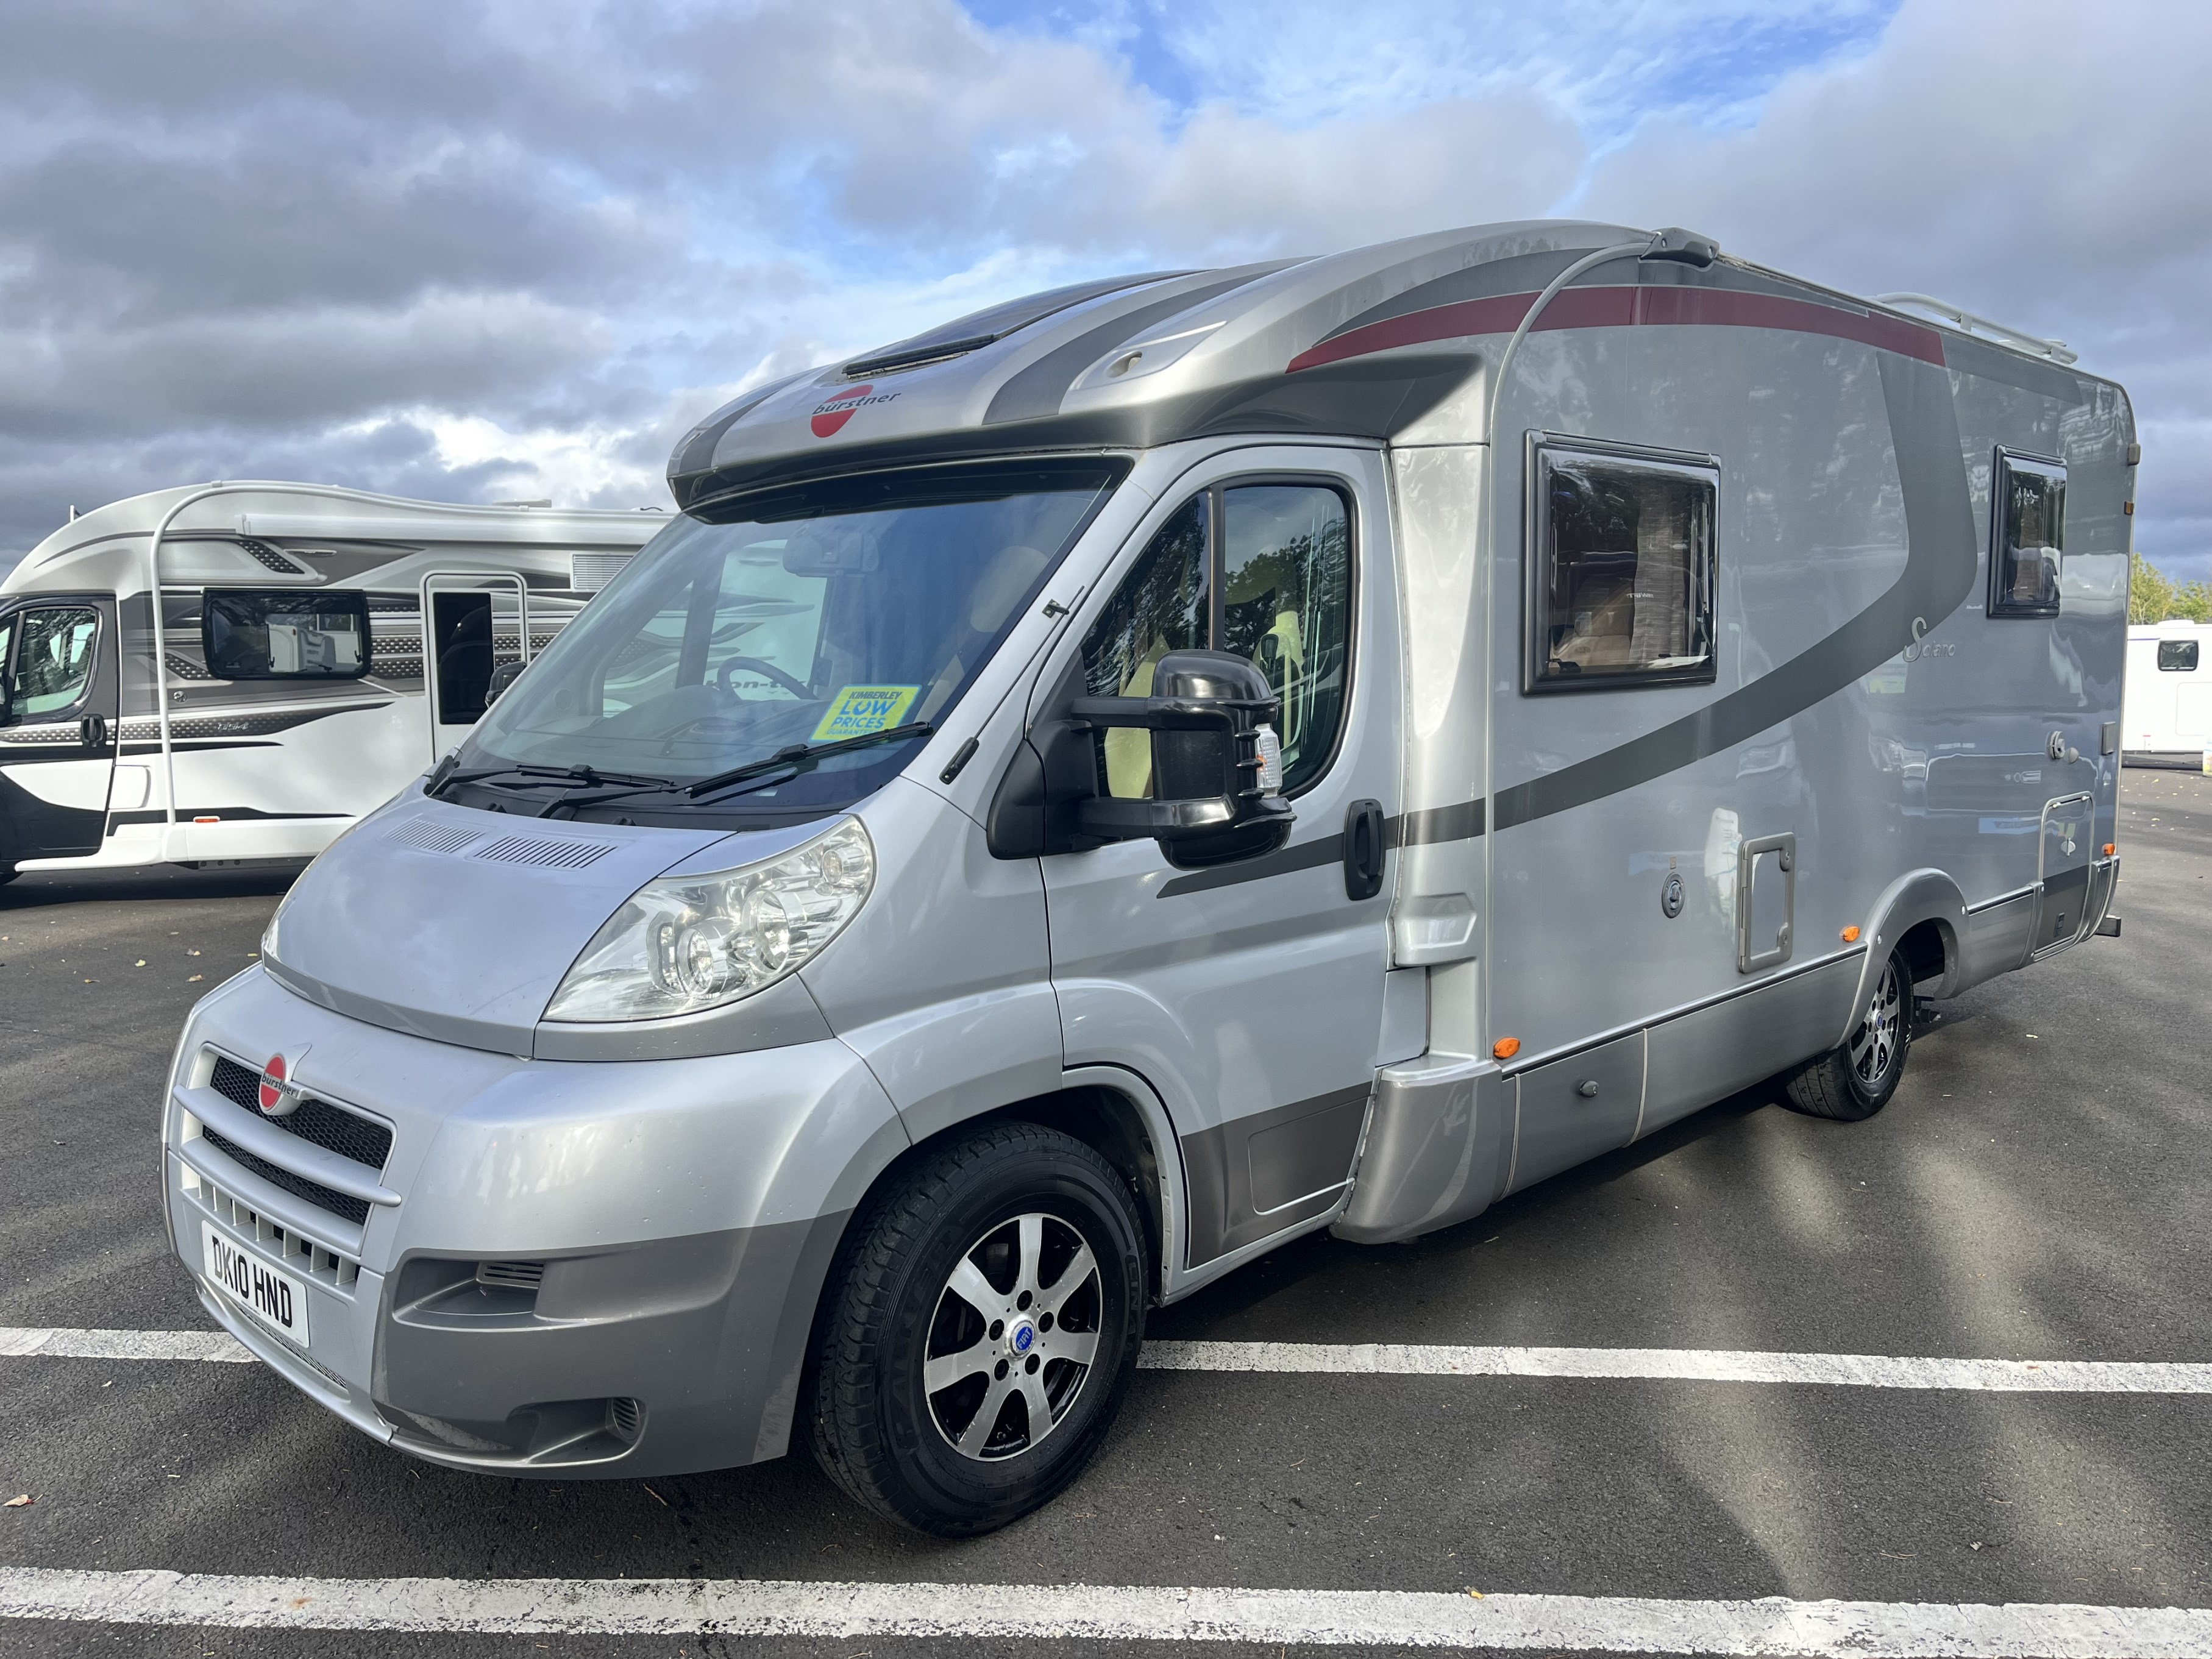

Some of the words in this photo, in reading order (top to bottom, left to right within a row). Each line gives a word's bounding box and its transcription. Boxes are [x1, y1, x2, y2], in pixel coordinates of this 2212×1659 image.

[812, 393, 902, 415] bürstner
[1902, 616, 1955, 663] Solano
[848, 691, 903, 700] KIMBERLEY
[839, 701, 898, 716] LOW
[831, 717, 886, 728] PRICES
[261, 1073, 296, 1095] bürstner
[212, 1235, 249, 1299] DK10
[253, 1263, 293, 1328] HND
[1017, 1327, 1031, 1349] FIAT
